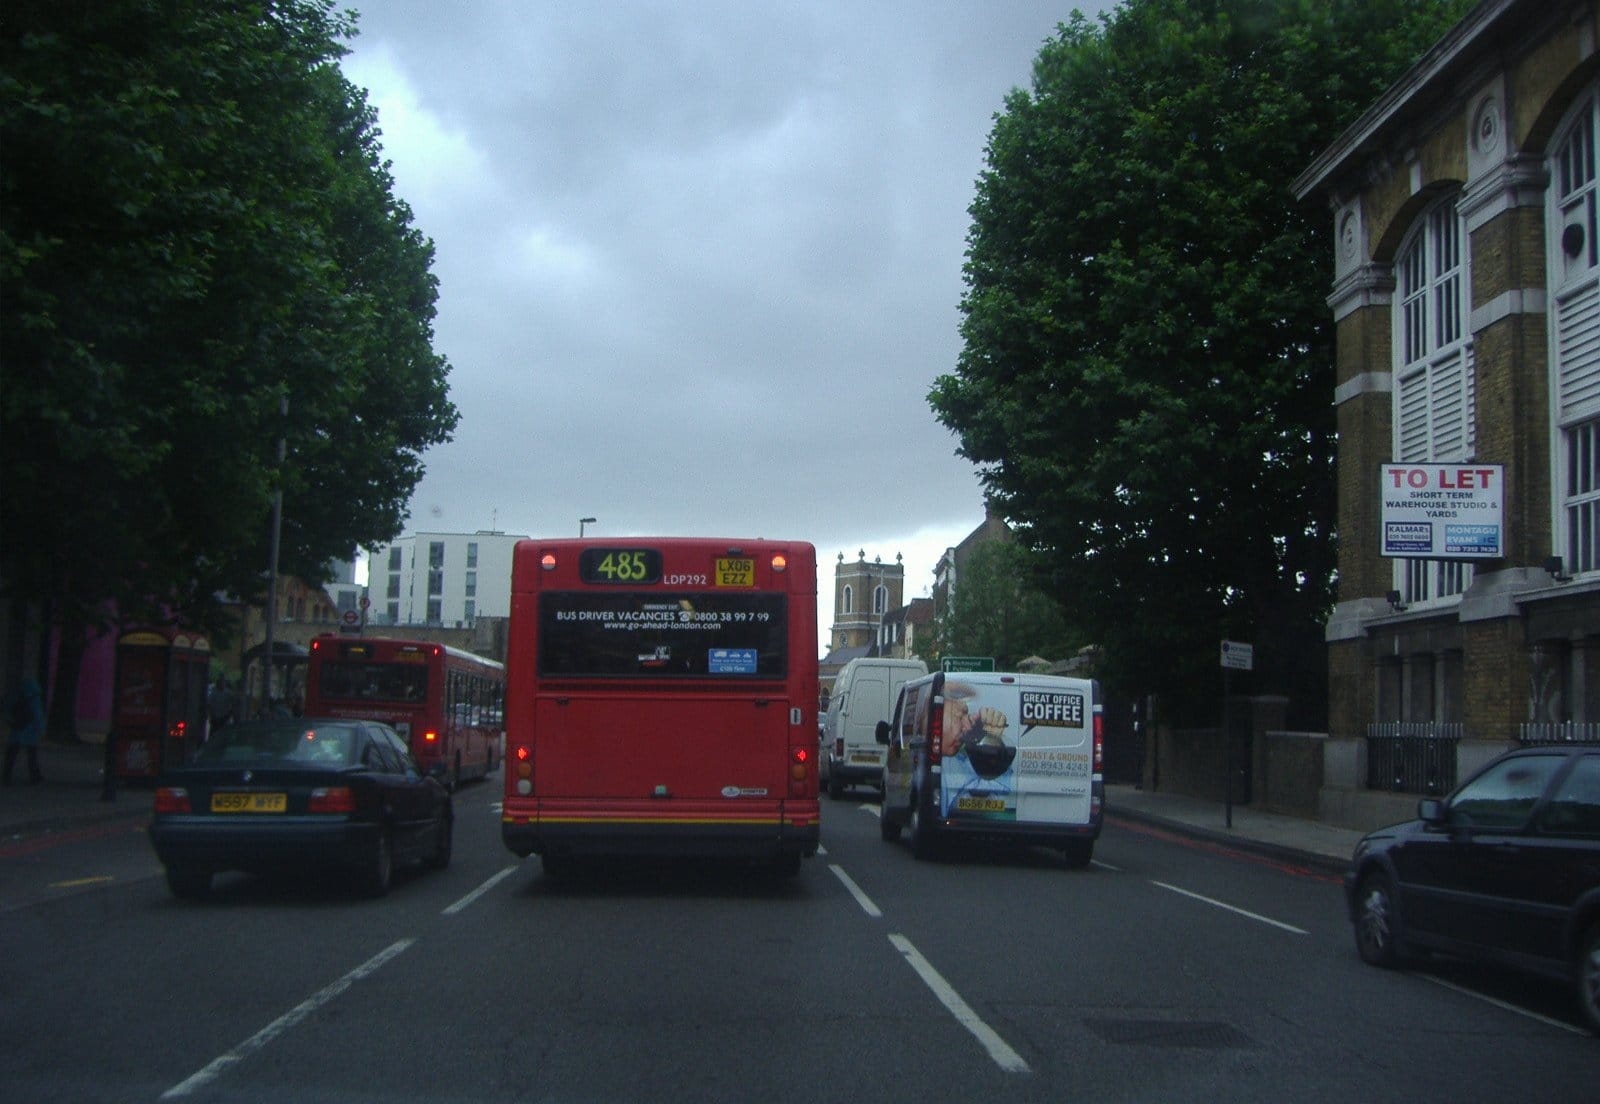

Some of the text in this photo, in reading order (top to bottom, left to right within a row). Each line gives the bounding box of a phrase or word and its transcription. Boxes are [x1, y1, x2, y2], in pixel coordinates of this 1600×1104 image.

[1388, 469, 1494, 489] TO LET
[1425, 510, 1457, 518] YARDS
[598, 552, 646, 580] 485
[719, 560, 751, 572] LX06
[664, 575, 707, 585] LDP292
[723, 573, 747, 585] EZZ
[557, 611, 769, 622] BUS DRIVER VACANCIES 0800 38 99 7 99
[604, 622, 721, 631] www.go-ahead-london.com
[1023, 693, 1081, 705] GREAT OFFICE
[1023, 703, 1081, 721] COFFEE
[1022, 751, 1047, 760] ROAST
[1057, 752, 1088, 762] GROUND
